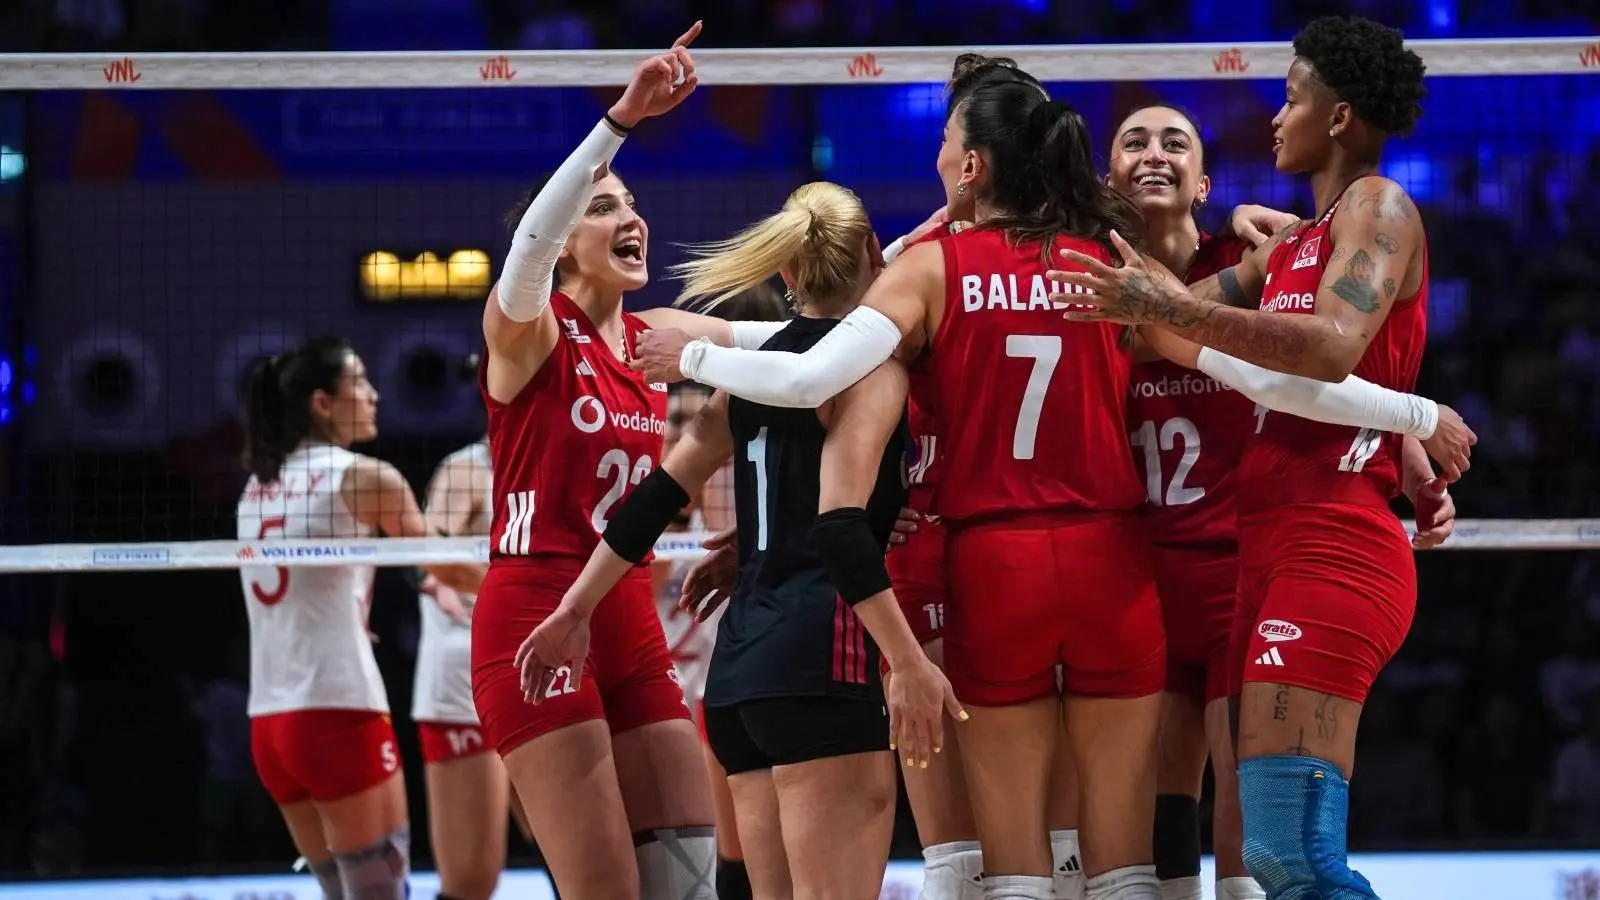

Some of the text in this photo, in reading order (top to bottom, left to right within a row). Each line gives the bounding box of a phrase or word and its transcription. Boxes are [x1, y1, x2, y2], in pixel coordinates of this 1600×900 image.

[479, 55, 517, 81] VNL
[846, 52, 884, 78] VNL
[1213, 48, 1250, 73] VNL
[1579, 44, 1600, 67] VN
[103, 57, 142, 83] VNL
[962, 273, 1094, 313] BALAD
[1260, 291, 1314, 312] afone
[1006, 334, 1062, 460] 7
[610, 411, 666, 436] vodafon
[1131, 416, 1206, 506] 12
[747, 426, 768, 551] 1
[262, 547, 344, 556] VOLLEYBALL
[1260, 622, 1298, 637] gratis
[545, 664, 577, 698] 22
[381, 739, 397, 772] 5
